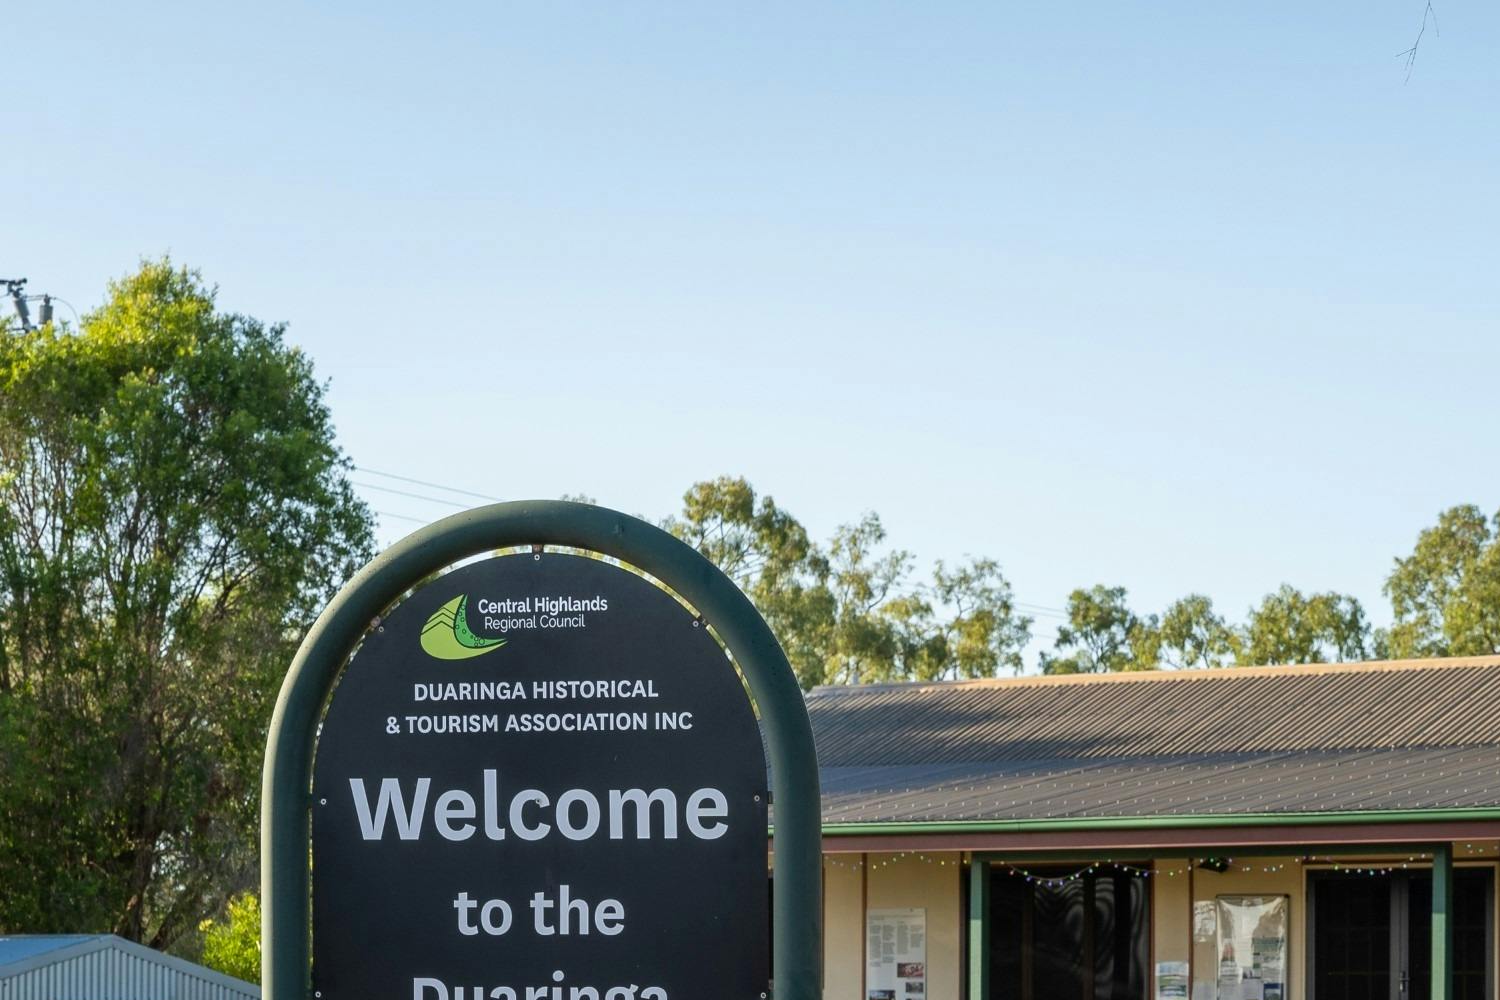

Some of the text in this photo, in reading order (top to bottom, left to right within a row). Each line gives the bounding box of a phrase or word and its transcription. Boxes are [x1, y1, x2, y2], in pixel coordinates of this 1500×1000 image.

[477, 595, 609, 616] Central Highlands
[484, 612, 586, 633] Regional Council
[414, 679, 659, 702] DUARINGA HISTORICAL
[385, 711, 693, 735] & TOURISM ASSOCIATION INC
[348, 768, 729, 842] Welcome
[453, 884, 625, 936] to the
